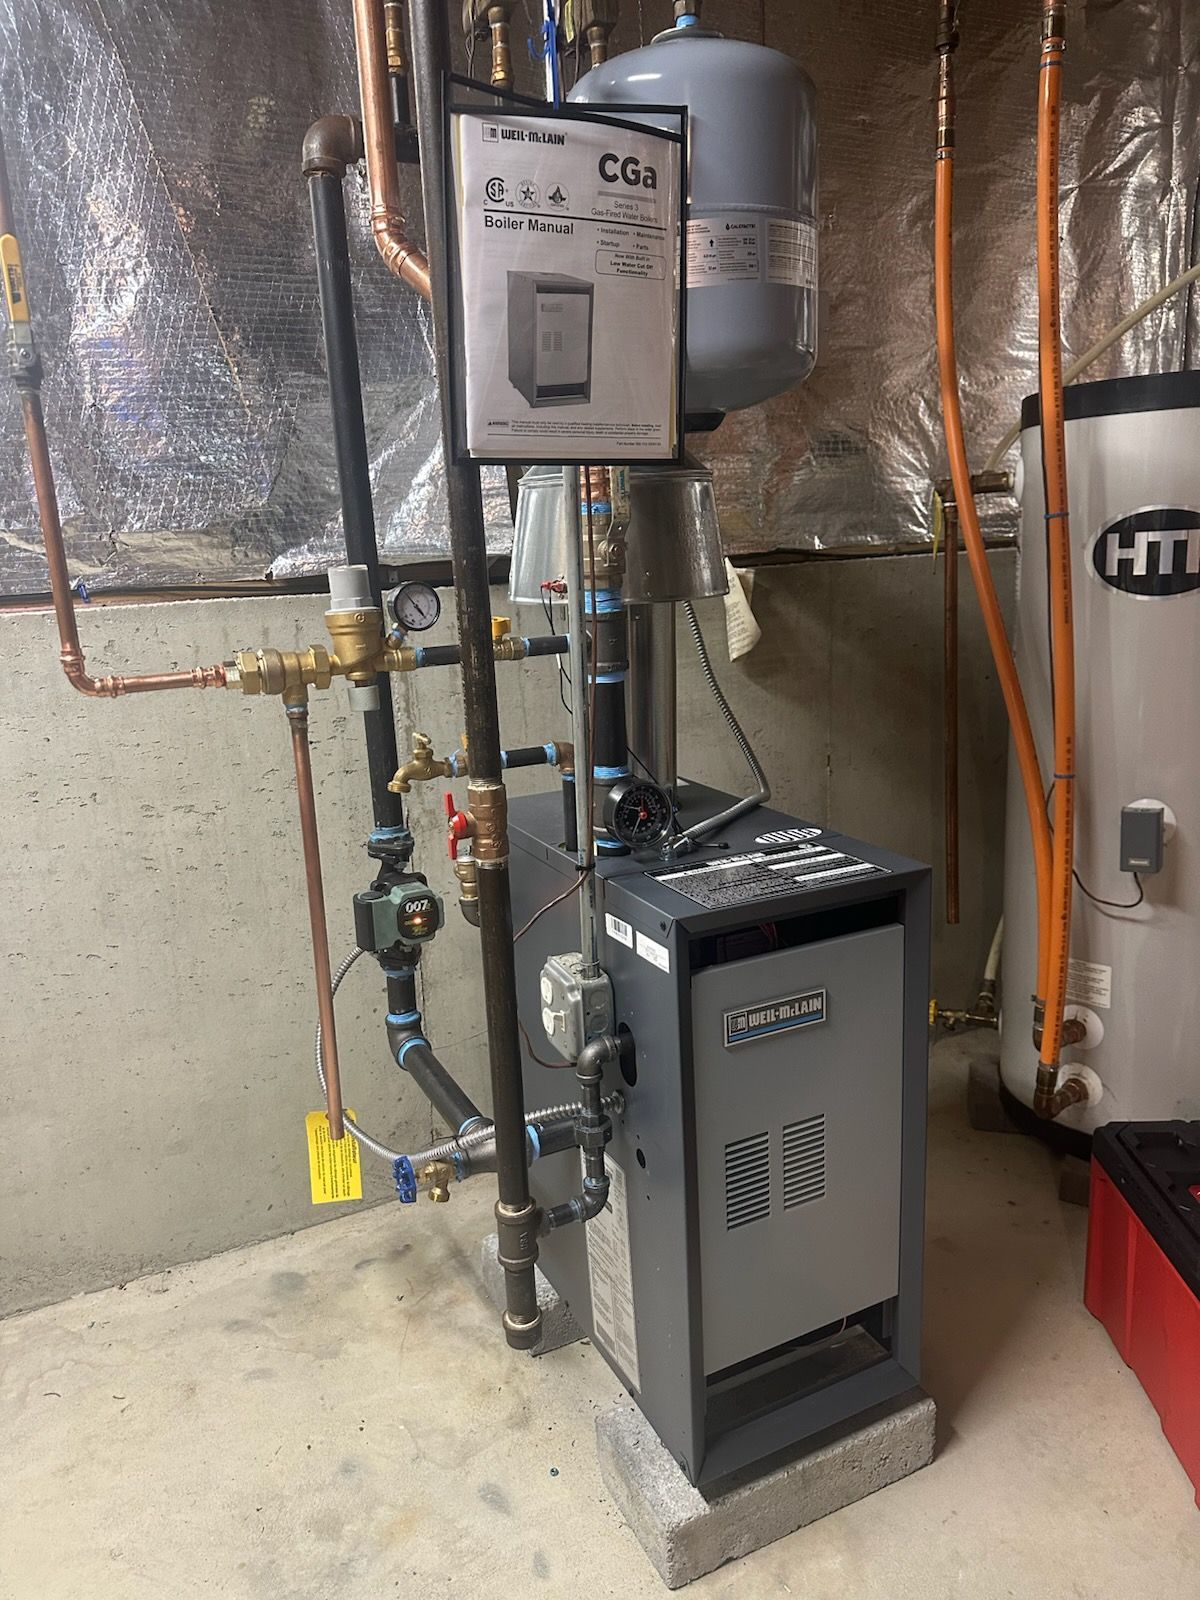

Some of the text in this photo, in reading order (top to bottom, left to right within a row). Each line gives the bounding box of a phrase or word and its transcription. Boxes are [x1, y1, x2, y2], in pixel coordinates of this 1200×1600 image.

[598, 153, 657, 189] CGa
[614, 200, 639, 212] Series 3
[591, 207, 658, 223] Gas-Fired Water Boilers
[484, 215, 574, 235] Boiler Manual
[600, 227, 629, 236] Installation
[600, 239, 649, 251] Startup Parts
